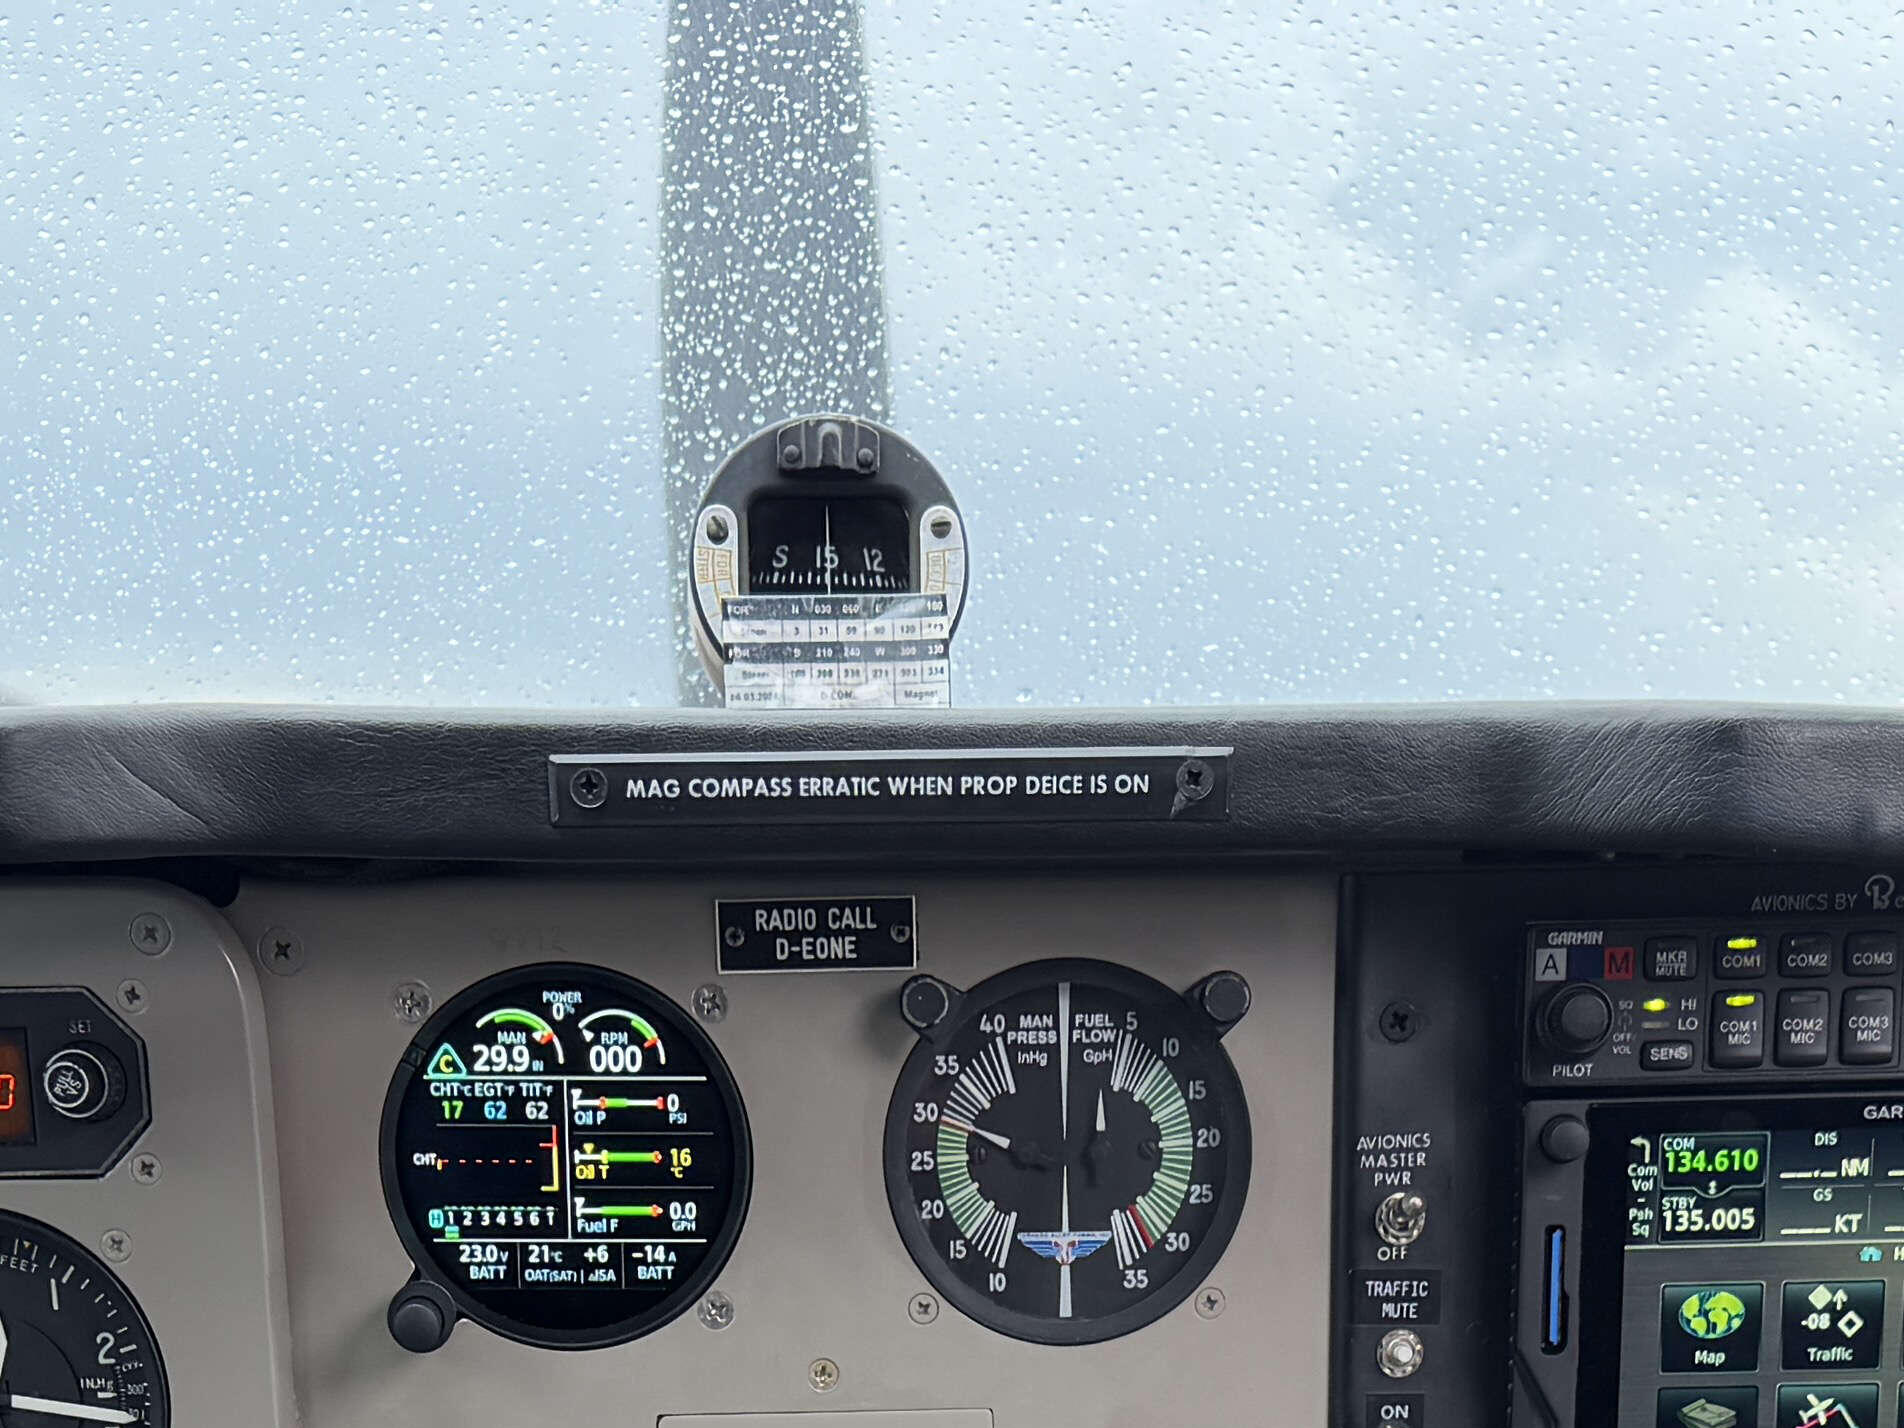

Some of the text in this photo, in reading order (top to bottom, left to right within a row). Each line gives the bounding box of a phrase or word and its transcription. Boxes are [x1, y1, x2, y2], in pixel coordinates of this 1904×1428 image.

[815, 545, 885, 571] 15 12
[625, 774, 1149, 799] MAG COMPASS ERRATIC WHEN PROP DEICE IS ON
[754, 907, 877, 932] RADIO CALL
[775, 936, 857, 961] D-EONE
[1721, 954, 1762, 969] COM1
[1019, 1015, 1052, 1029] MAN
[1075, 1013, 1115, 1028] FUEL
[1006, 1030, 1058, 1044] PRESS
[1072, 1028, 1116, 1043] FLOW
[472, 1044, 531, 1073] 29.9
[589, 1044, 642, 1073] 000
[1356, 1134, 1432, 1151] AVIONICS
[1360, 1152, 1427, 1169] MASTER
[1664, 1147, 1759, 1176] 134.610
[1373, 1171, 1413, 1187] PWR
[1661, 1207, 1756, 1232] 135.005
[1377, 1245, 1409, 1261] OFF
[1365, 1281, 1429, 1299] TRAFFIC
[1380, 1302, 1418, 1319] MUTE
[1694, 1348, 1725, 1368] Map
[1806, 1345, 1853, 1363] Traffic
